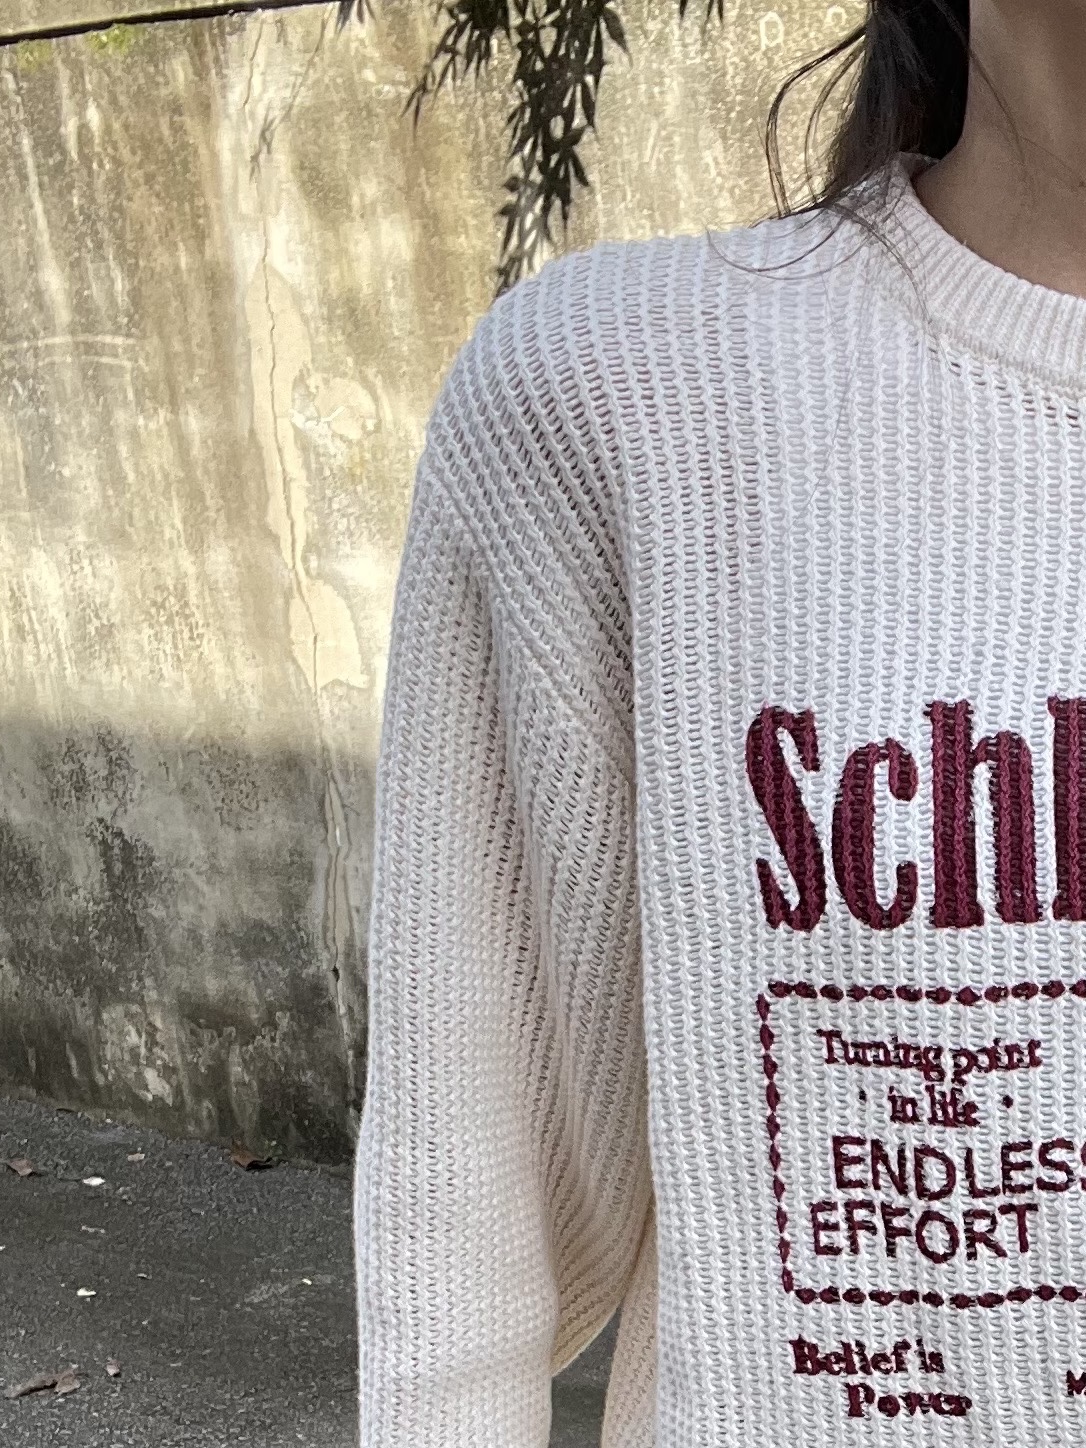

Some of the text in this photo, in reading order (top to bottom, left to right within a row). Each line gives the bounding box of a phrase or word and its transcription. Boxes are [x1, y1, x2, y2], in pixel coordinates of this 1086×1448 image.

[887, 1085, 922, 1125] in
[810, 1200, 1039, 1265] EFFORT
[788, 1333, 912, 1376] Belief
